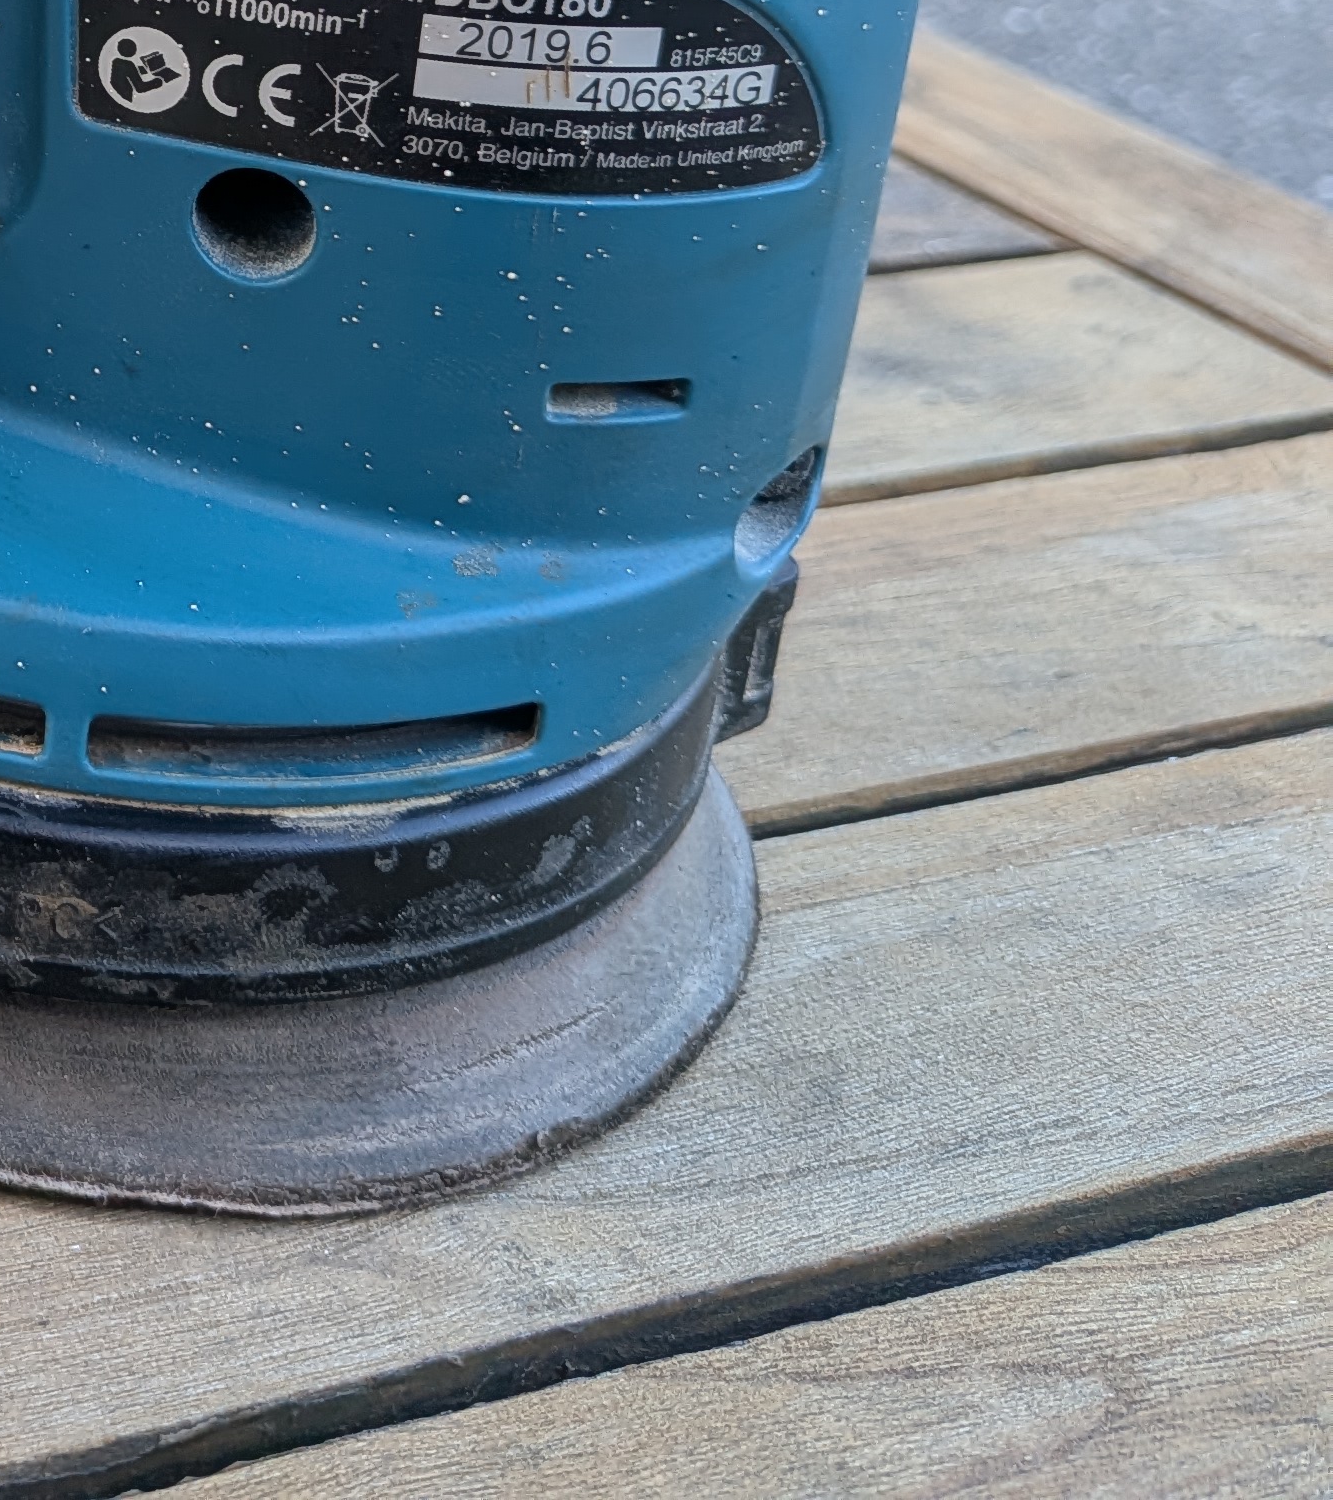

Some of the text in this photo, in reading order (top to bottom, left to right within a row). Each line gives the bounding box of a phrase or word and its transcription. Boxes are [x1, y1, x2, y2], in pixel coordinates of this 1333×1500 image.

[455, 22, 613, 65] 2019.6
[670, 45, 763, 68] 815F45C9
[576, 71, 762, 111] 406634G
[406, 106, 493, 135] Makita,
[500, 116, 635, 144] Jan-Baptist
[641, 116, 746, 140] Vinkstraat
[401, 135, 470, 162] 3070,
[477, 144, 576, 170] Belgium
[596, 152, 651, 169] Made
[654, 151, 672, 167] in
[677, 146, 733, 167] United
[737, 139, 805, 161] Kingdom
